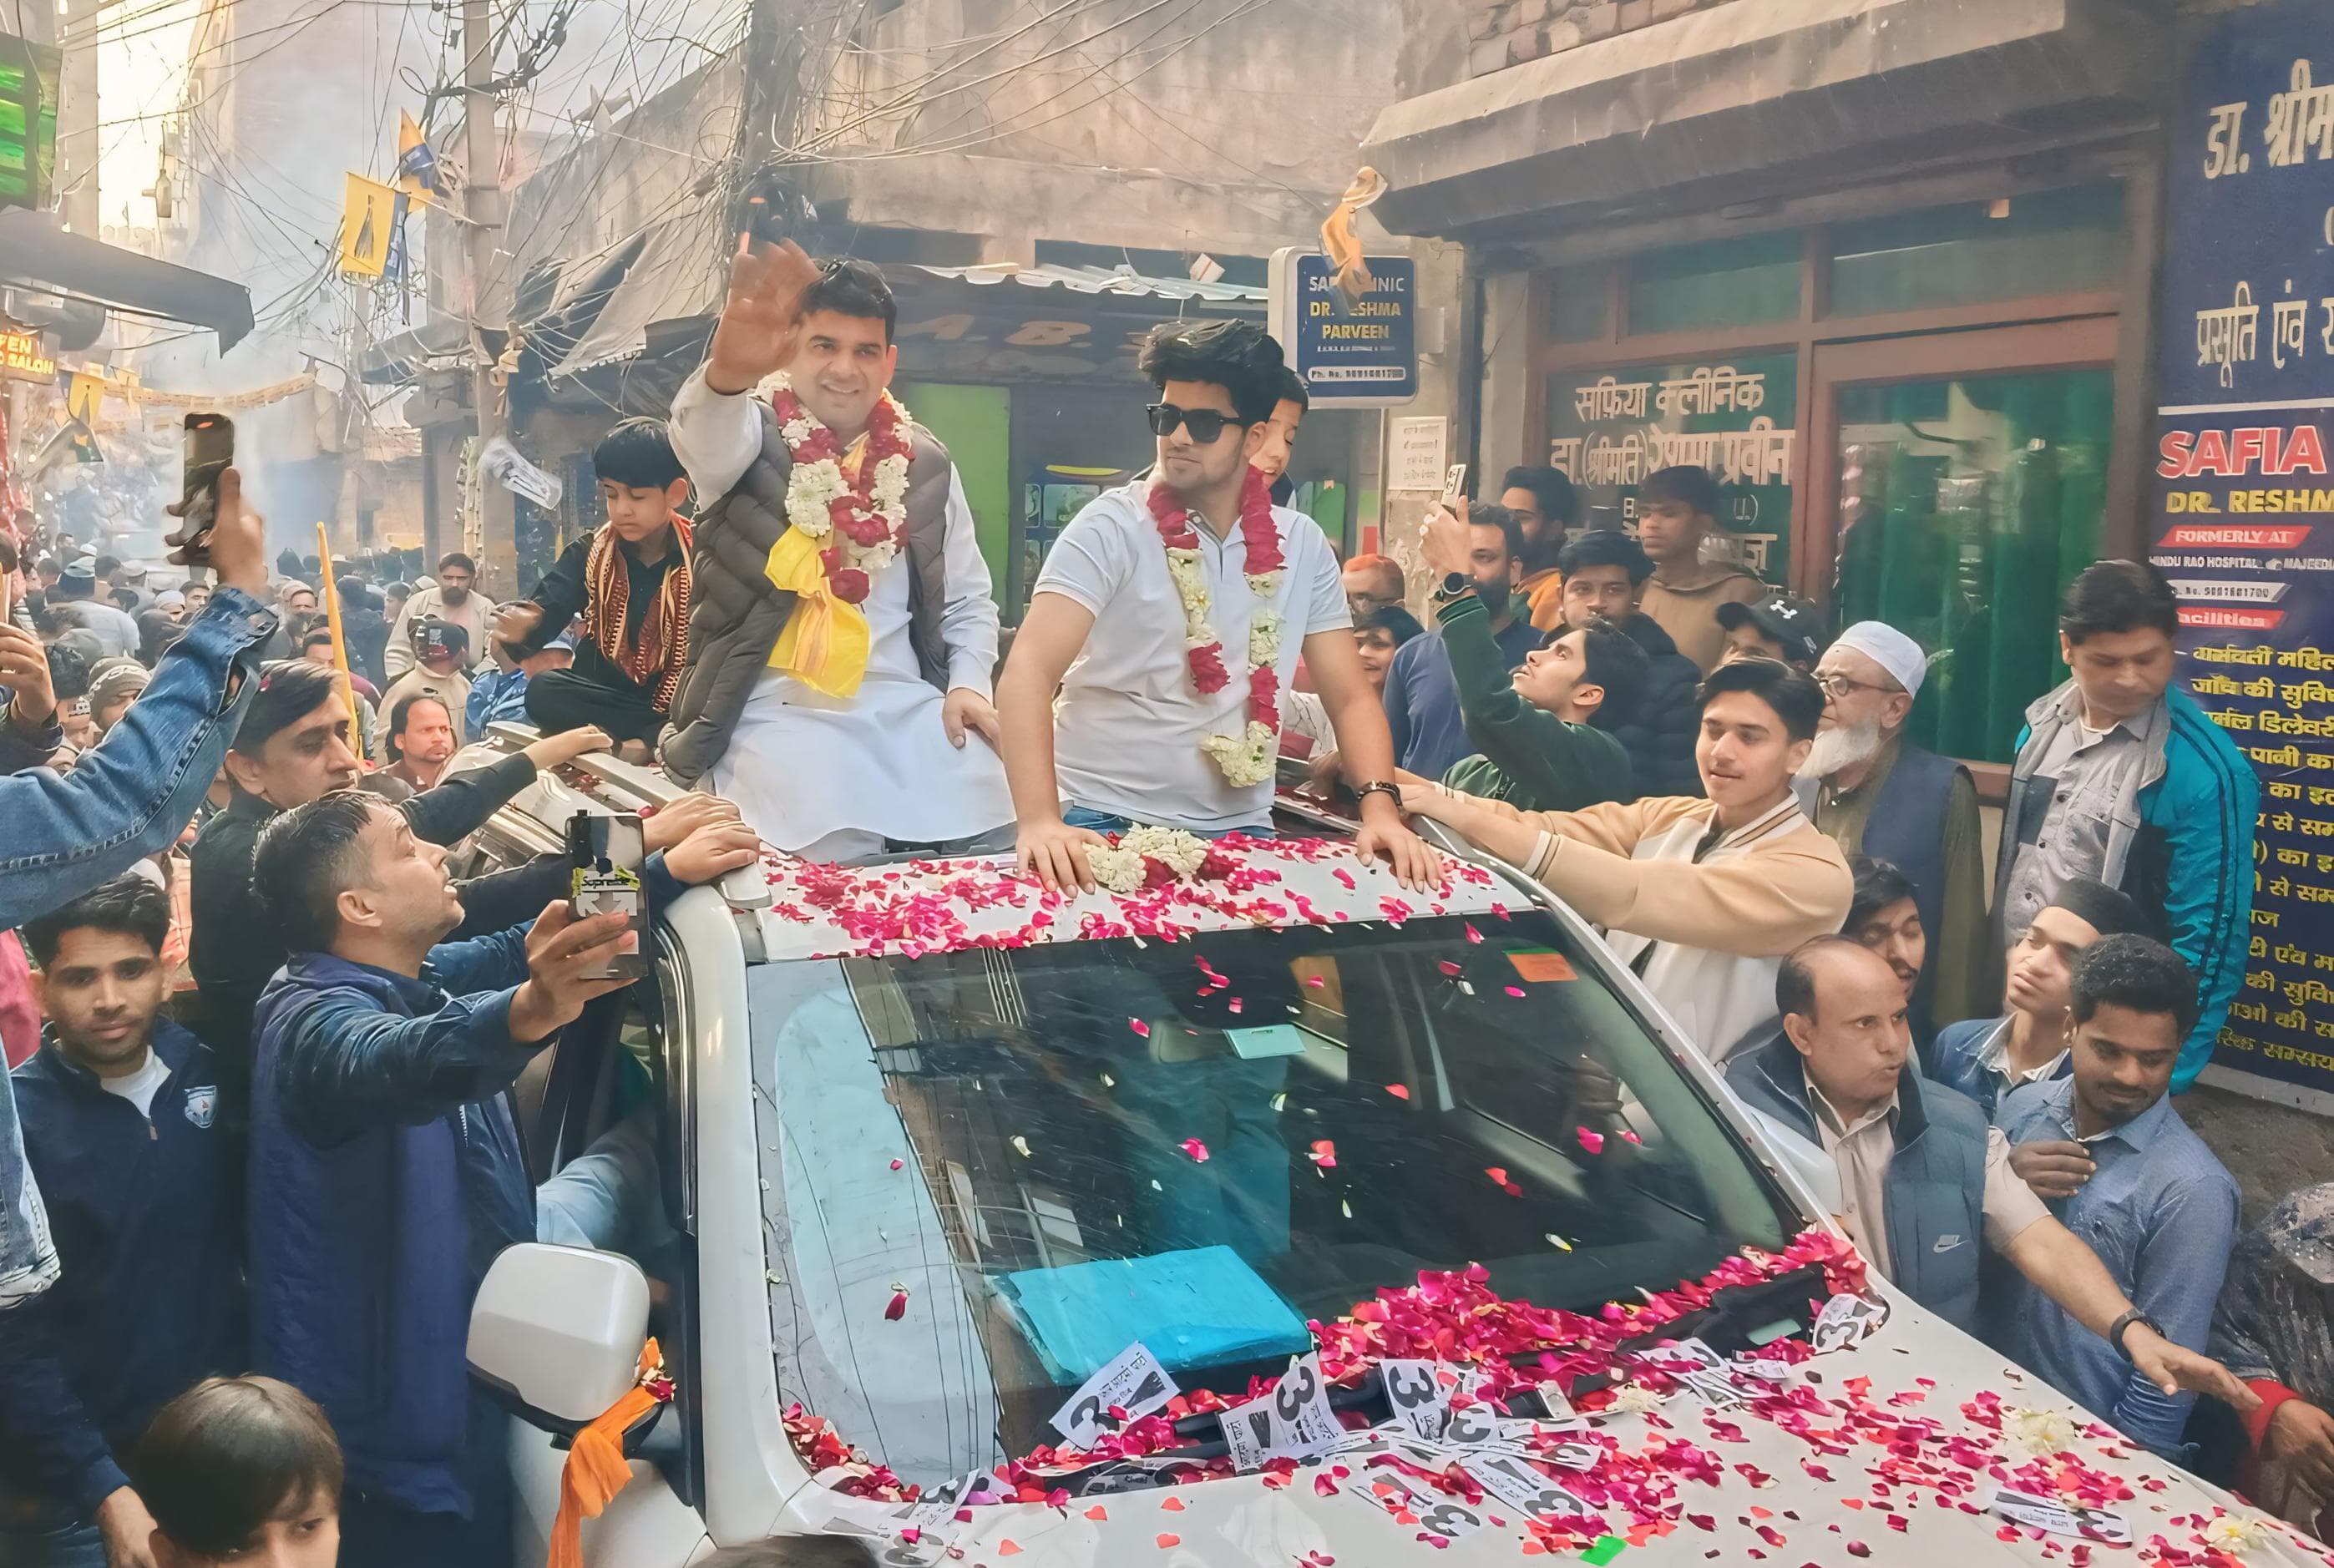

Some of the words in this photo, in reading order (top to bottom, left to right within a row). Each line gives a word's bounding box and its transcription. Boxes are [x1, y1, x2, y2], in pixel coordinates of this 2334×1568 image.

[2263, 58, 2334, 168] श्रीम
[1309, 301, 1336, 316] DR.
[1322, 324, 1390, 339] PARVEEN
[2156, 425, 2328, 479] SAFIA
[2175, 529, 2263, 544] FORMERLY
[2267, 530, 2296, 544] AT
[2183, 556, 2205, 568] RAO
[2206, 557, 2265, 569] HOSPITAL
[2177, 612, 2266, 627] acilities
[2269, 781, 2302, 800] का
[2276, 848, 2310, 867] का
[1276, 1366, 1316, 1421] 3
[1388, 1366, 1436, 1409] 3
[1420, 1505, 1481, 1536] 3
